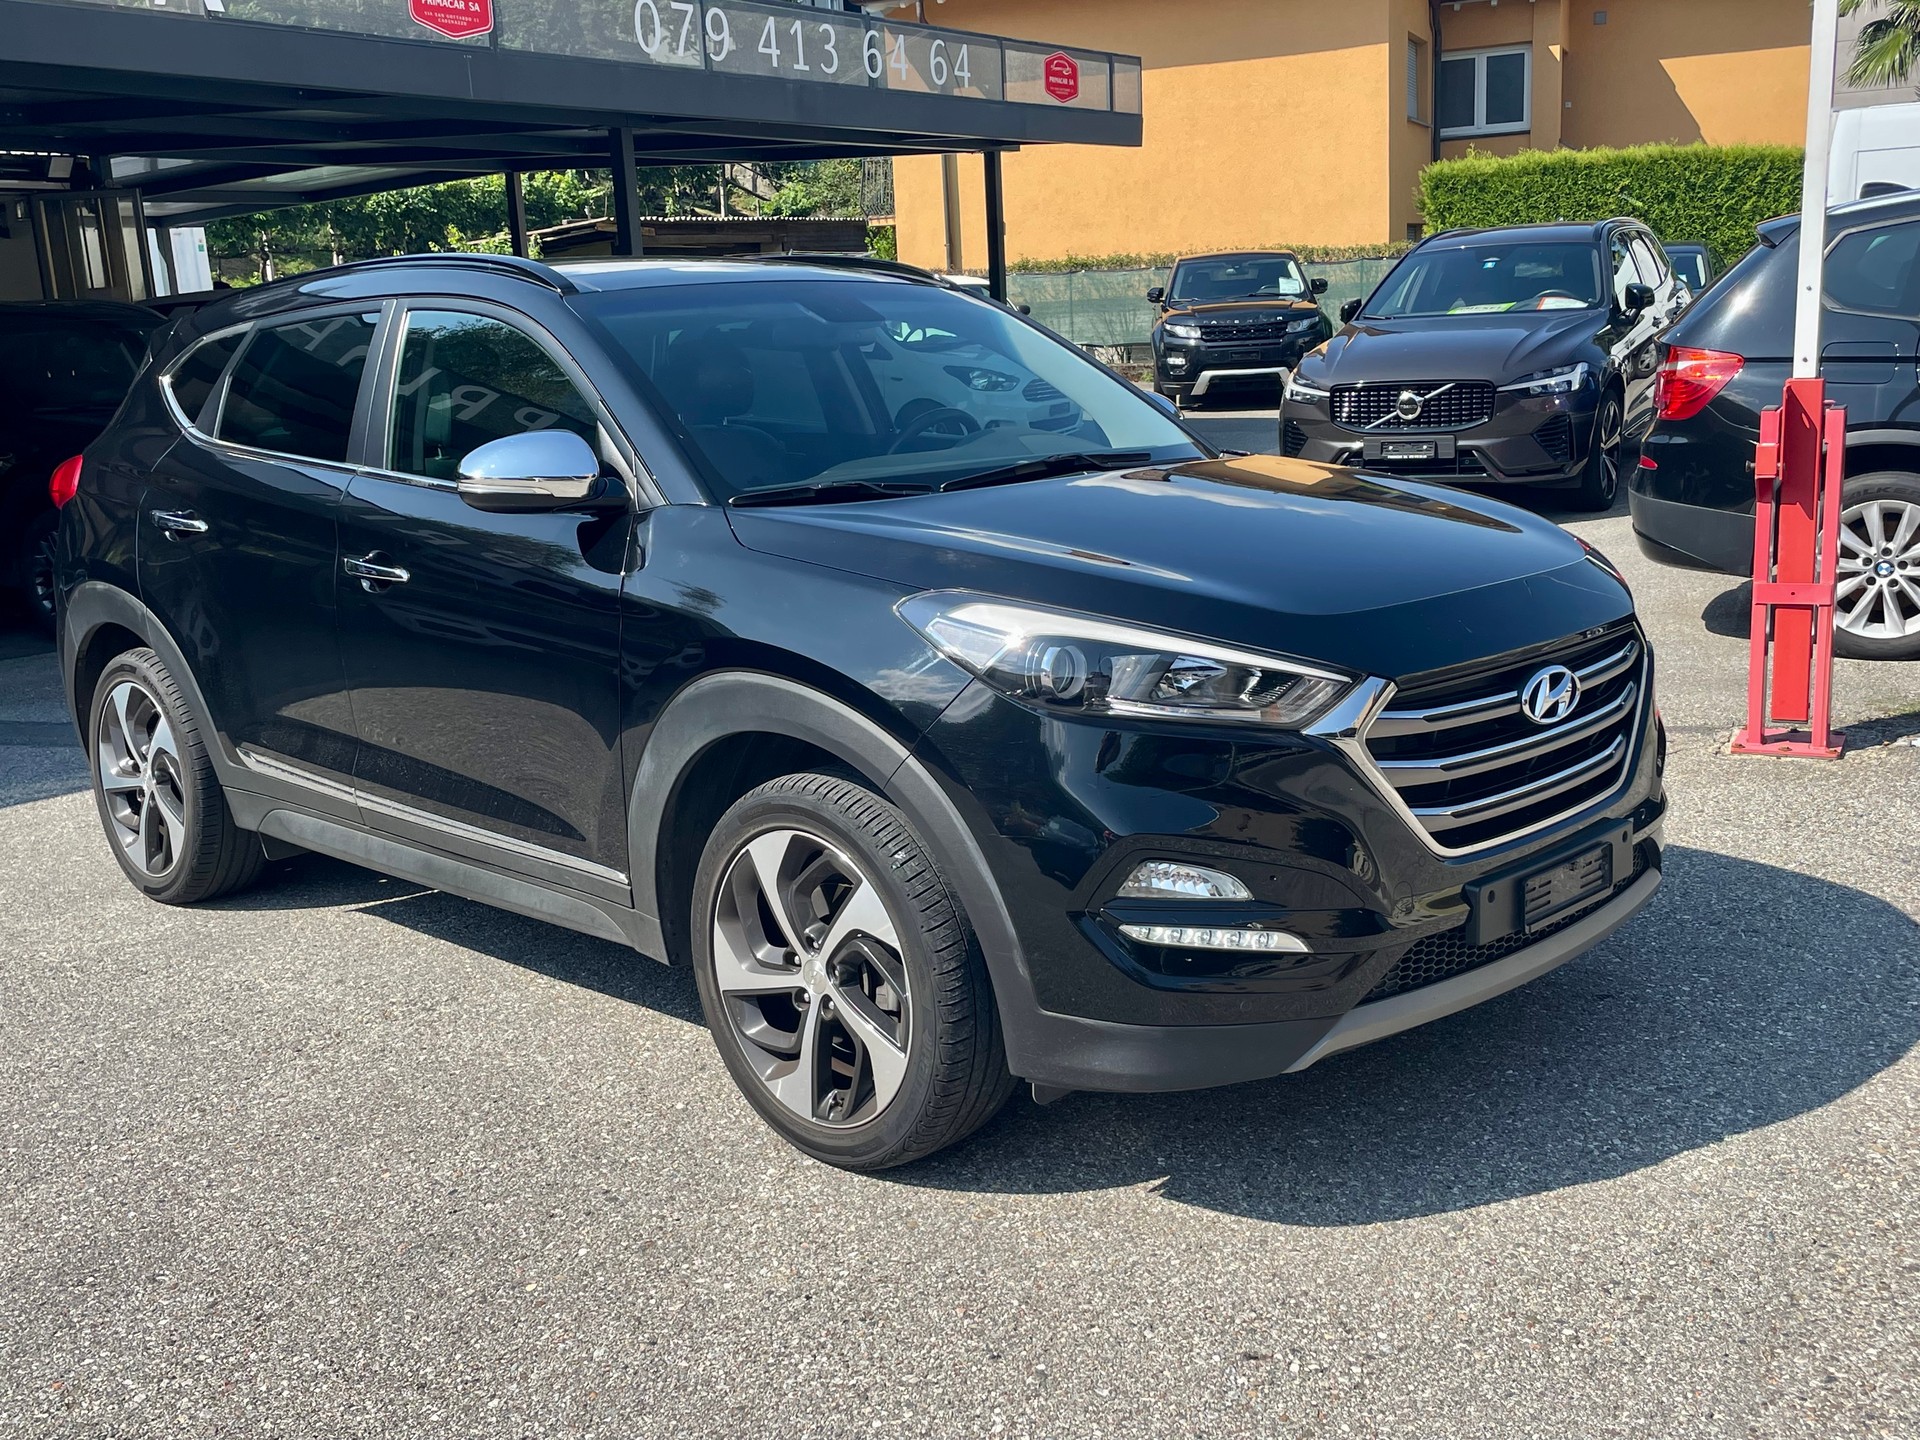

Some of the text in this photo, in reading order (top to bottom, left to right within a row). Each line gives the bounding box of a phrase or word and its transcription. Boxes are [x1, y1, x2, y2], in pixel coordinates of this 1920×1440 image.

[468, 2, 480, 12] SA
[634, 0, 971, 88] 079 413 64 64
